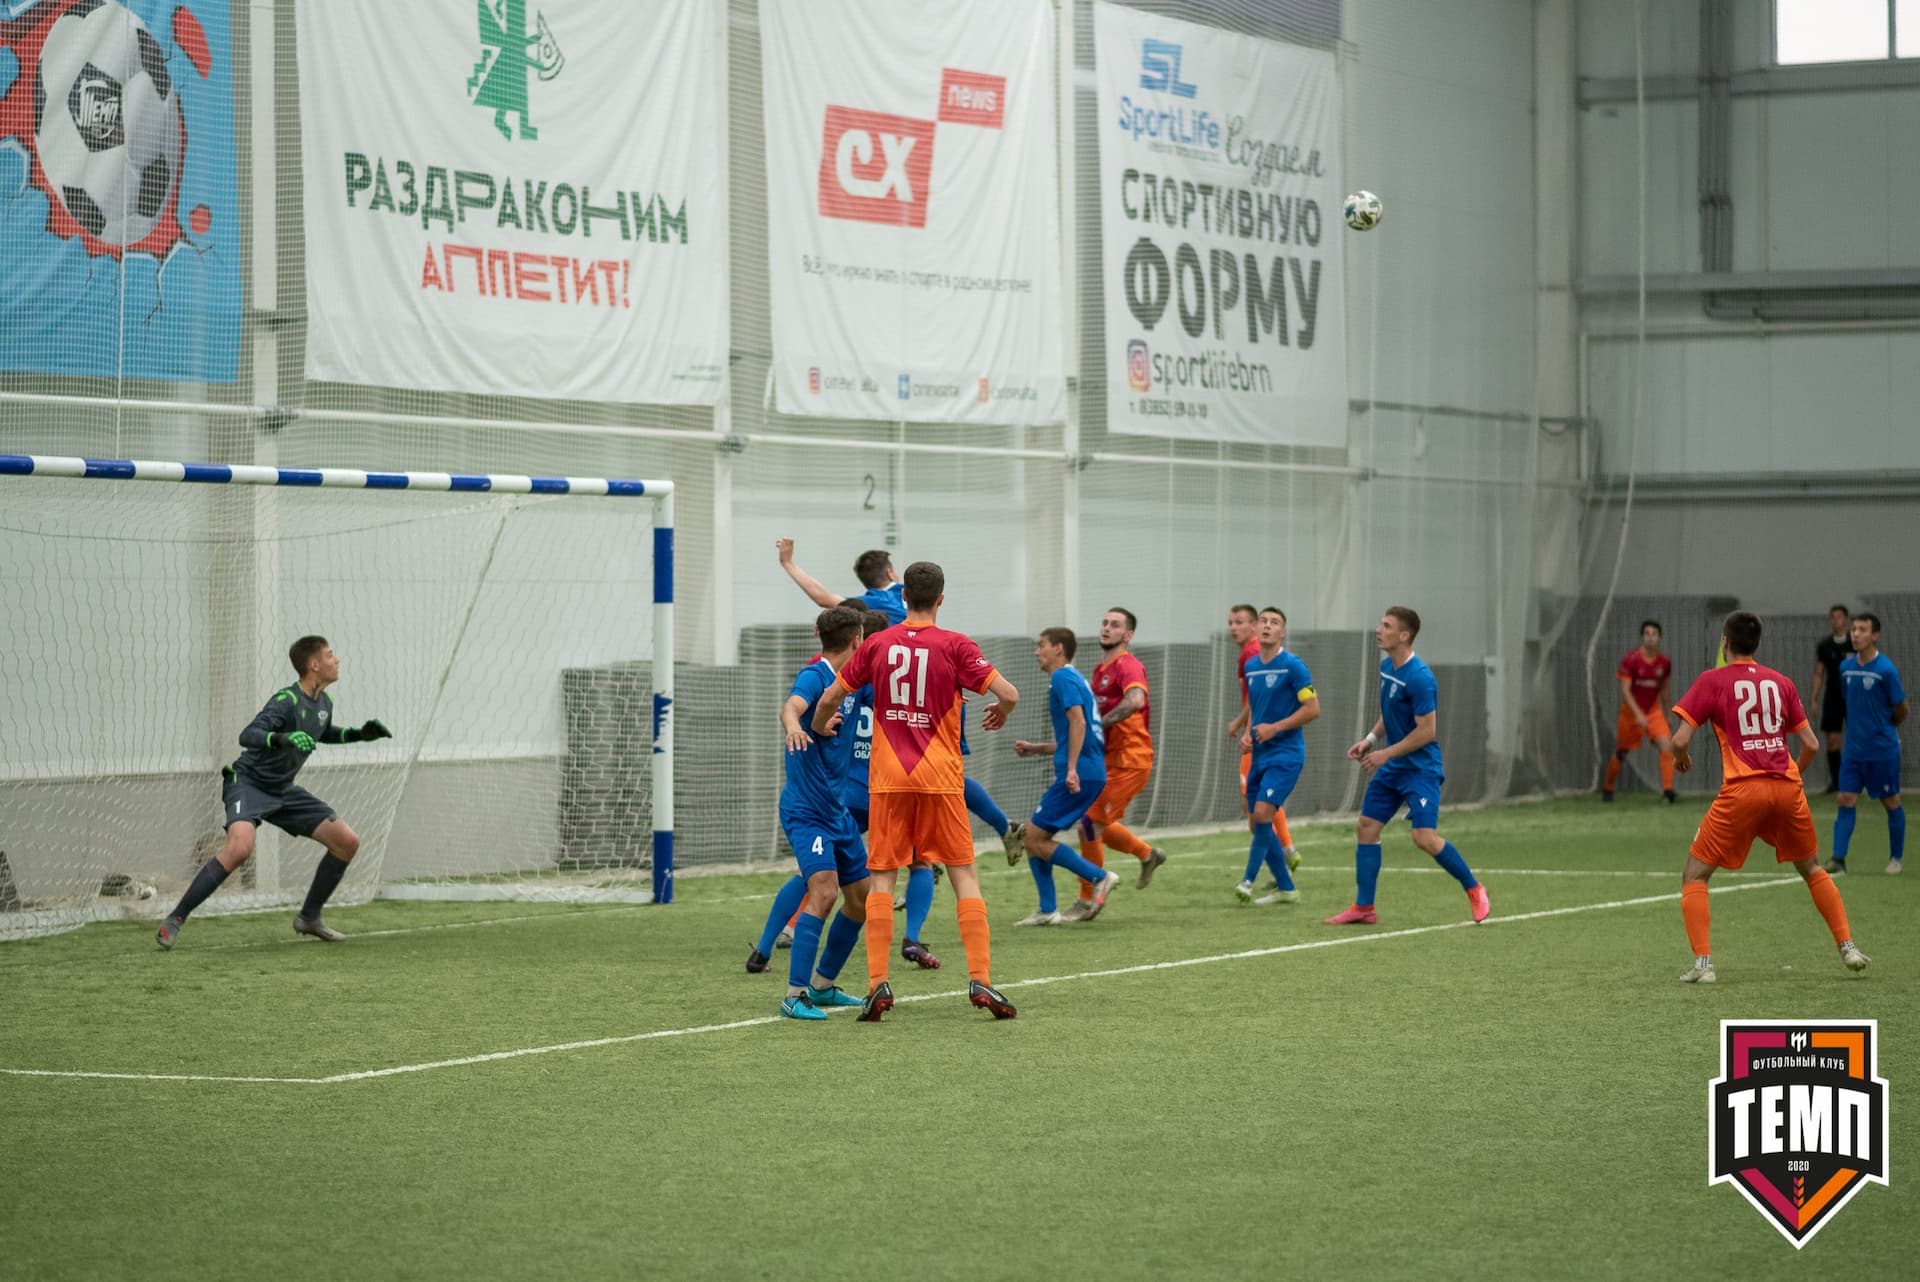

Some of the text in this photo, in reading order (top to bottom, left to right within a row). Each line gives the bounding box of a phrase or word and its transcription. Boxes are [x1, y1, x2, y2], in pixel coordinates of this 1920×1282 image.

[946, 85, 996, 112] news
[1119, 95, 1220, 149] SportLife
[344, 152, 688, 244] РАЗДРАКОНИМ
[1122, 168, 1322, 247] СПОРТИВНУЮ
[421, 240, 631, 309] АППЕТИТ!
[1124, 237, 1322, 350] ФОРМУ
[863, 473, 875, 511] 2
[888, 645, 929, 708] 21
[885, 710, 930, 724] SEUS
[1734, 680, 1783, 737] 20
[1742, 737, 1783, 751] SEUS
[235, 800, 241, 814] 1
[811, 836, 824, 856] 4
